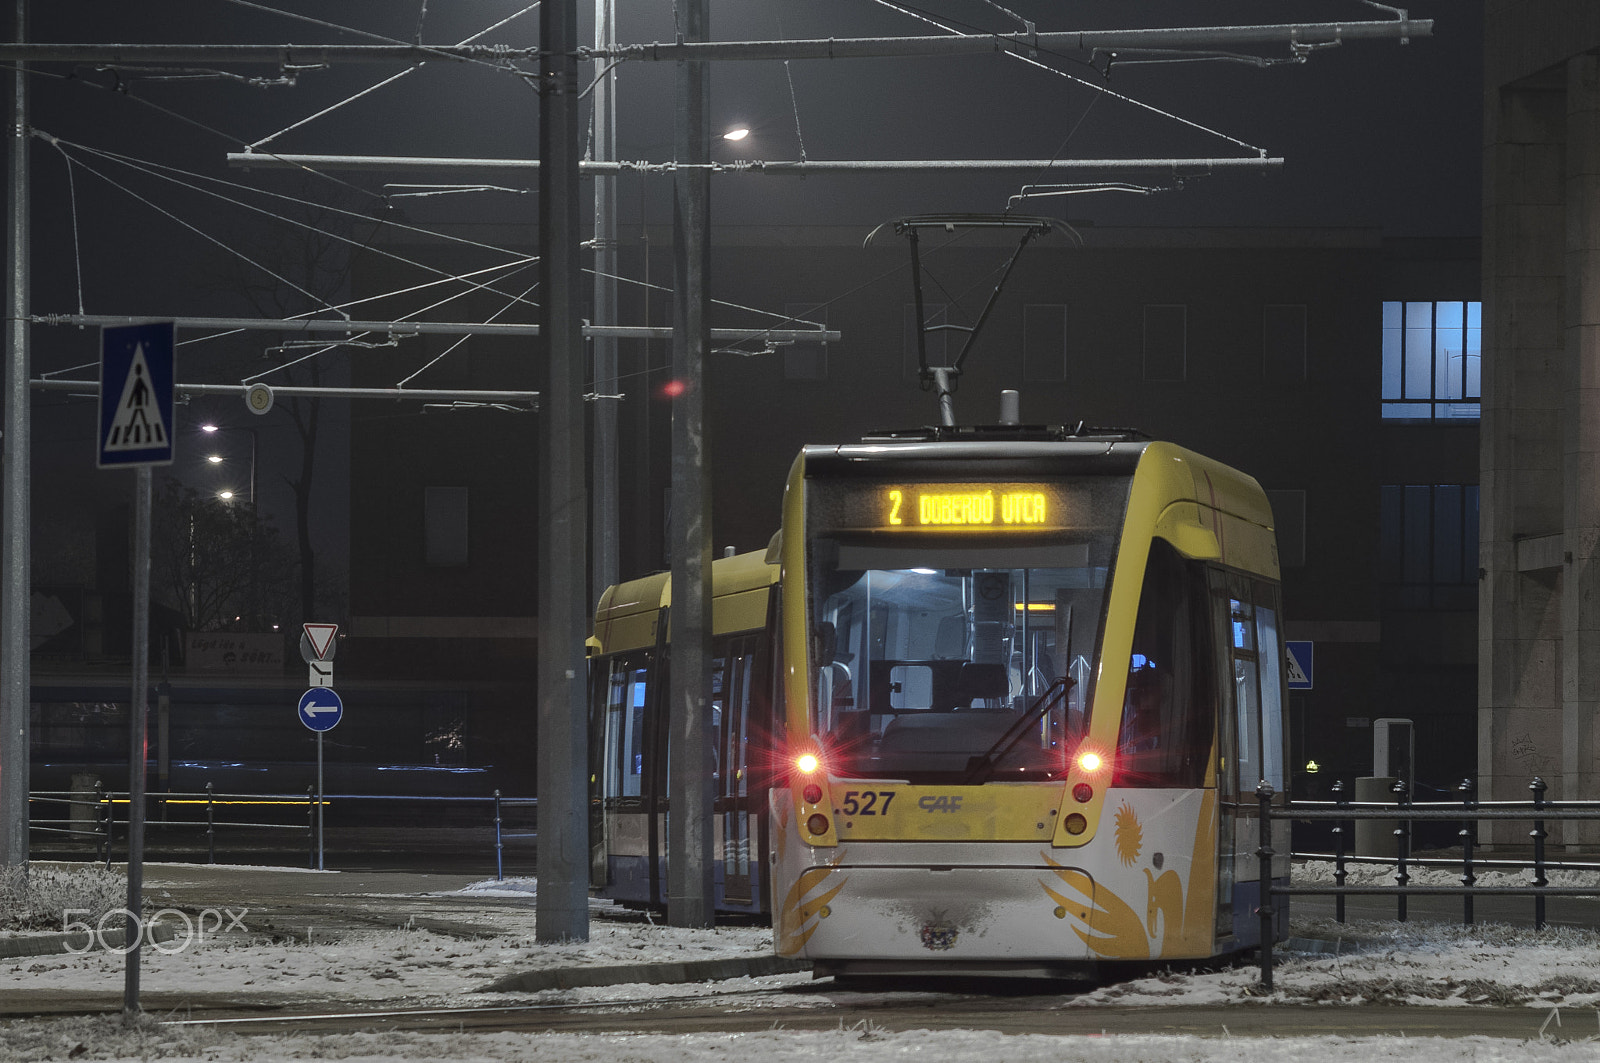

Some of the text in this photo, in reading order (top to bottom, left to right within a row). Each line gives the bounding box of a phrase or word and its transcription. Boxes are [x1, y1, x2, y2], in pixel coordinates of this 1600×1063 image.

[889, 489, 1046, 525] 2 DOBERDÓ UTCA
[843, 791, 895, 816] 527
[918, 795, 963, 814] CAF
